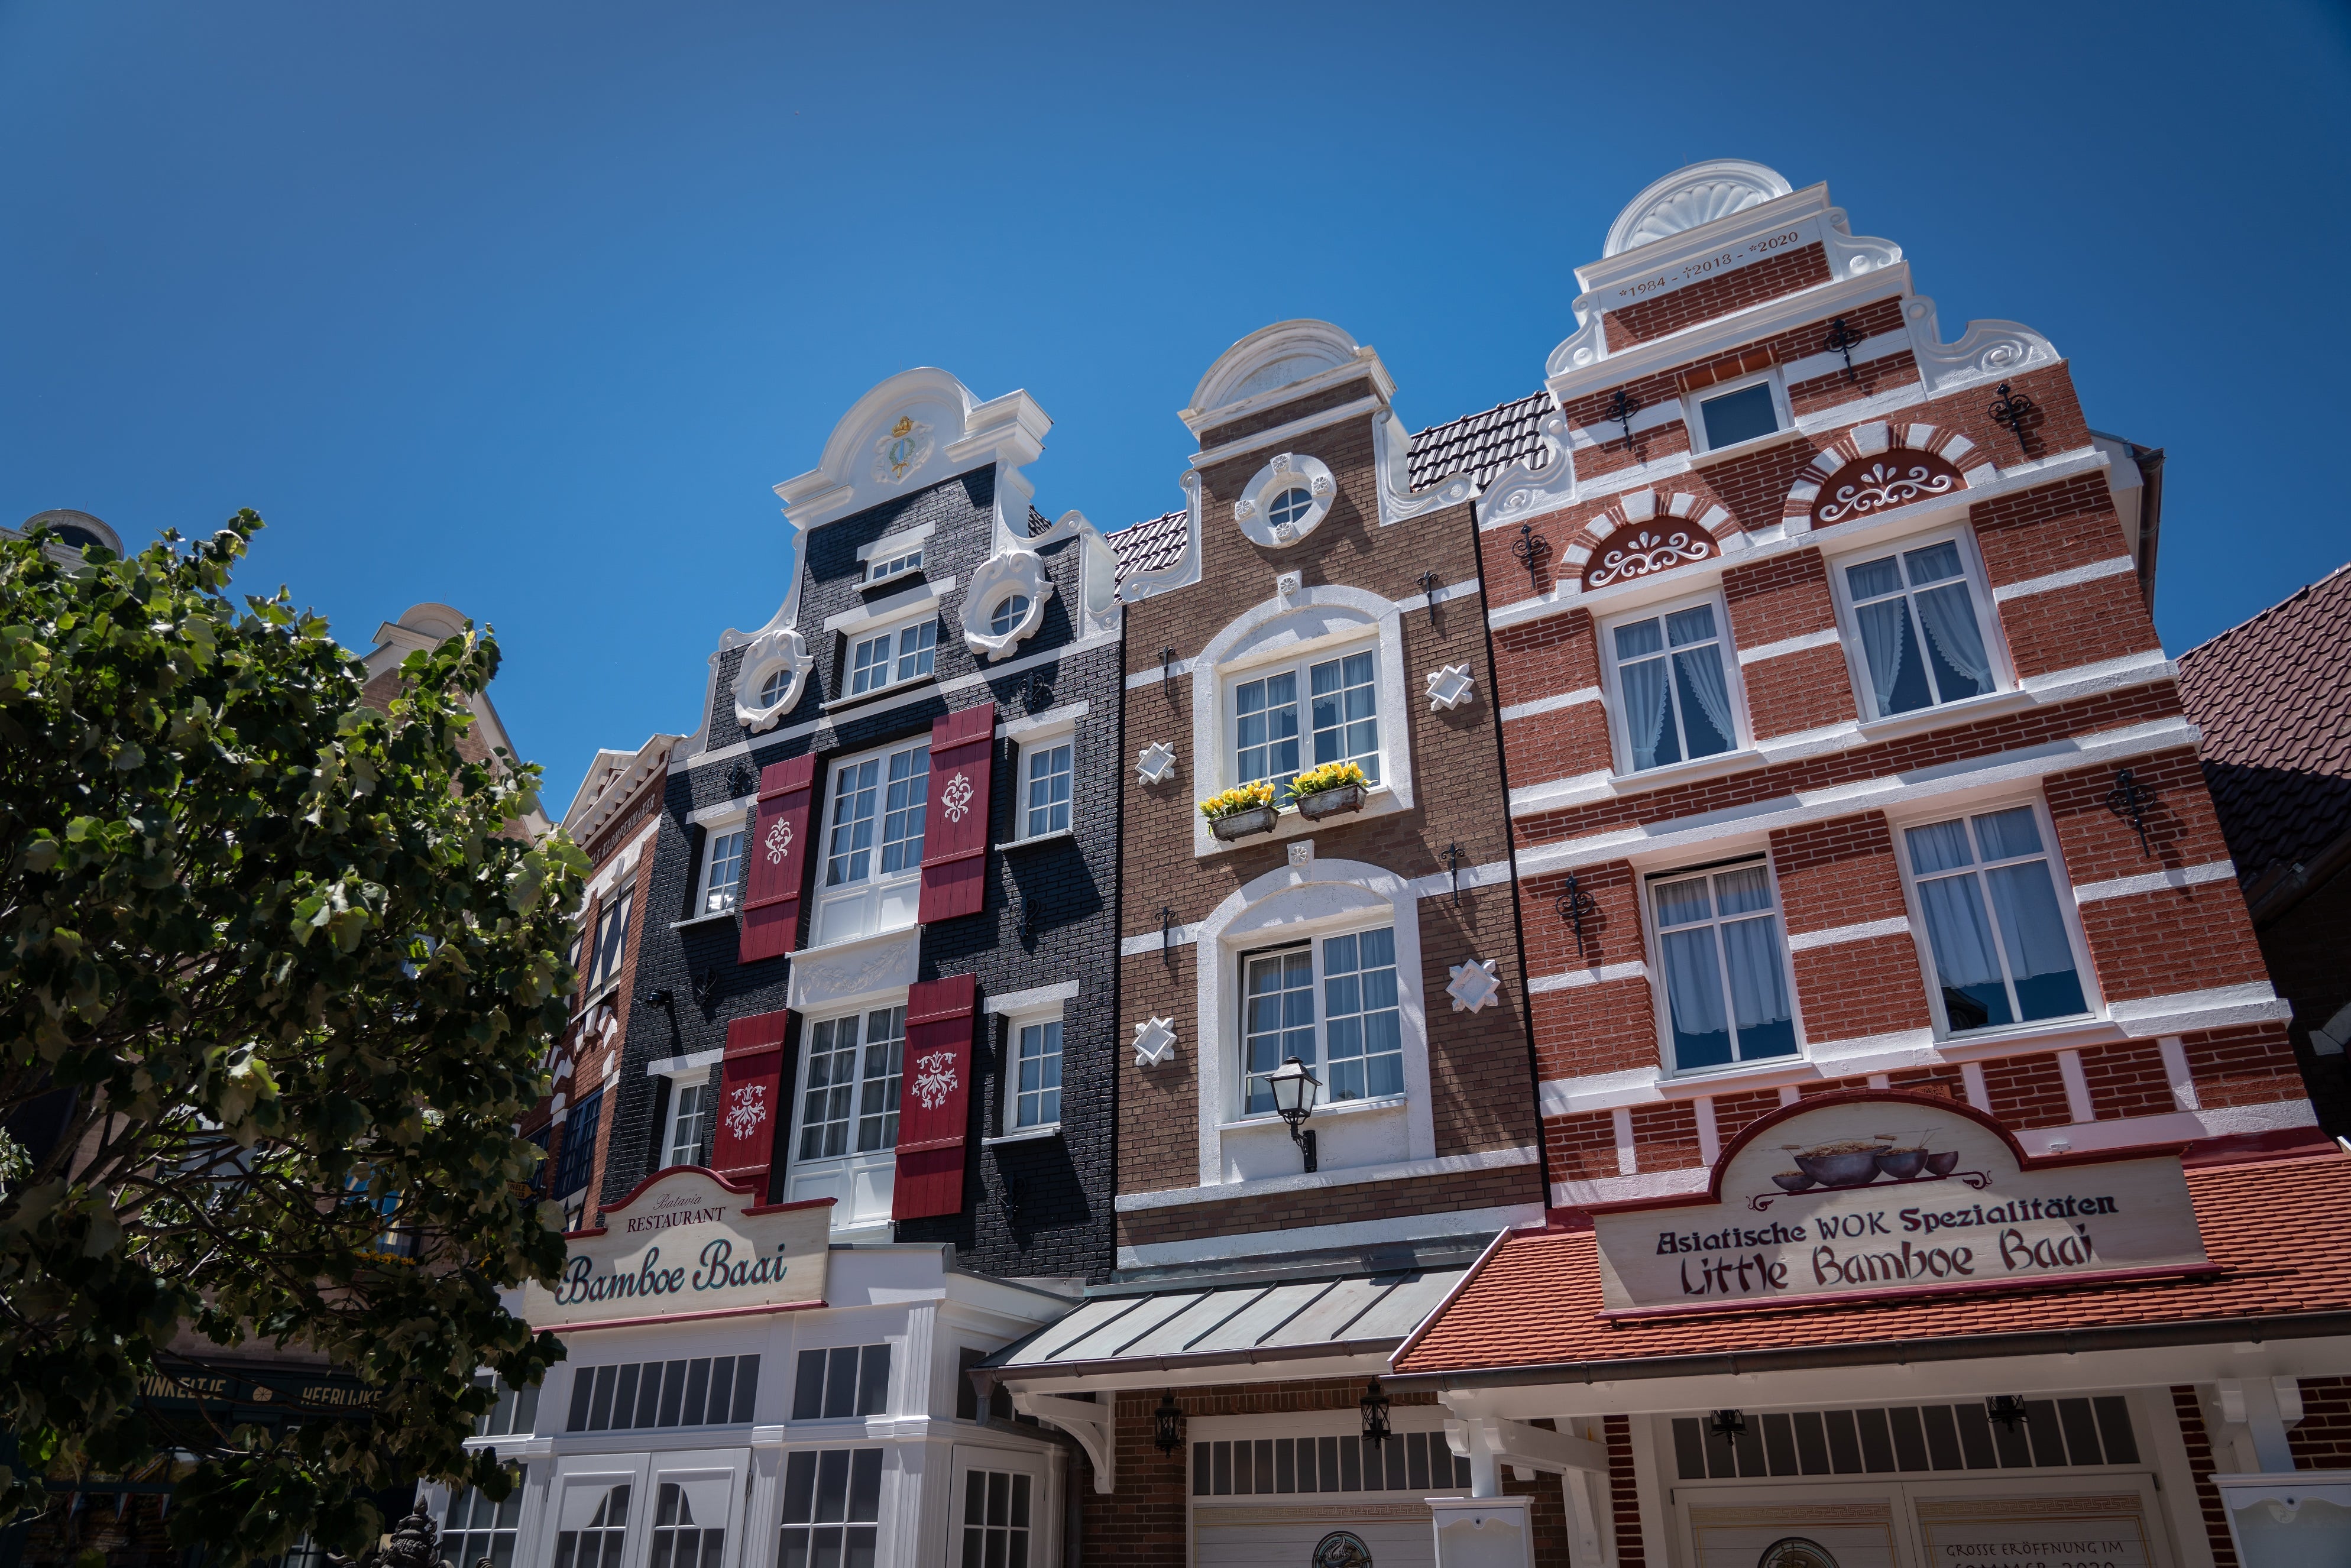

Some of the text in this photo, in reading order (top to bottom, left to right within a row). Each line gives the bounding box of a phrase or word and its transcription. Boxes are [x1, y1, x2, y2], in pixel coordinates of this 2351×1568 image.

[602, 793, 655, 858] KLOMPENMAKER
[627, 1206, 726, 1233] RESTAURANT
[653, 1193, 703, 1210] Batavia
[1656, 1196, 2119, 1255] Asiatische WOK Spezialitäten
[555, 1238, 787, 1305] Bamboe Baai
[1681, 1223, 2093, 1295] Little Bamboe Baai
[1947, 1541, 2124, 1557] GROSSE ERÖFFNUNG IM
